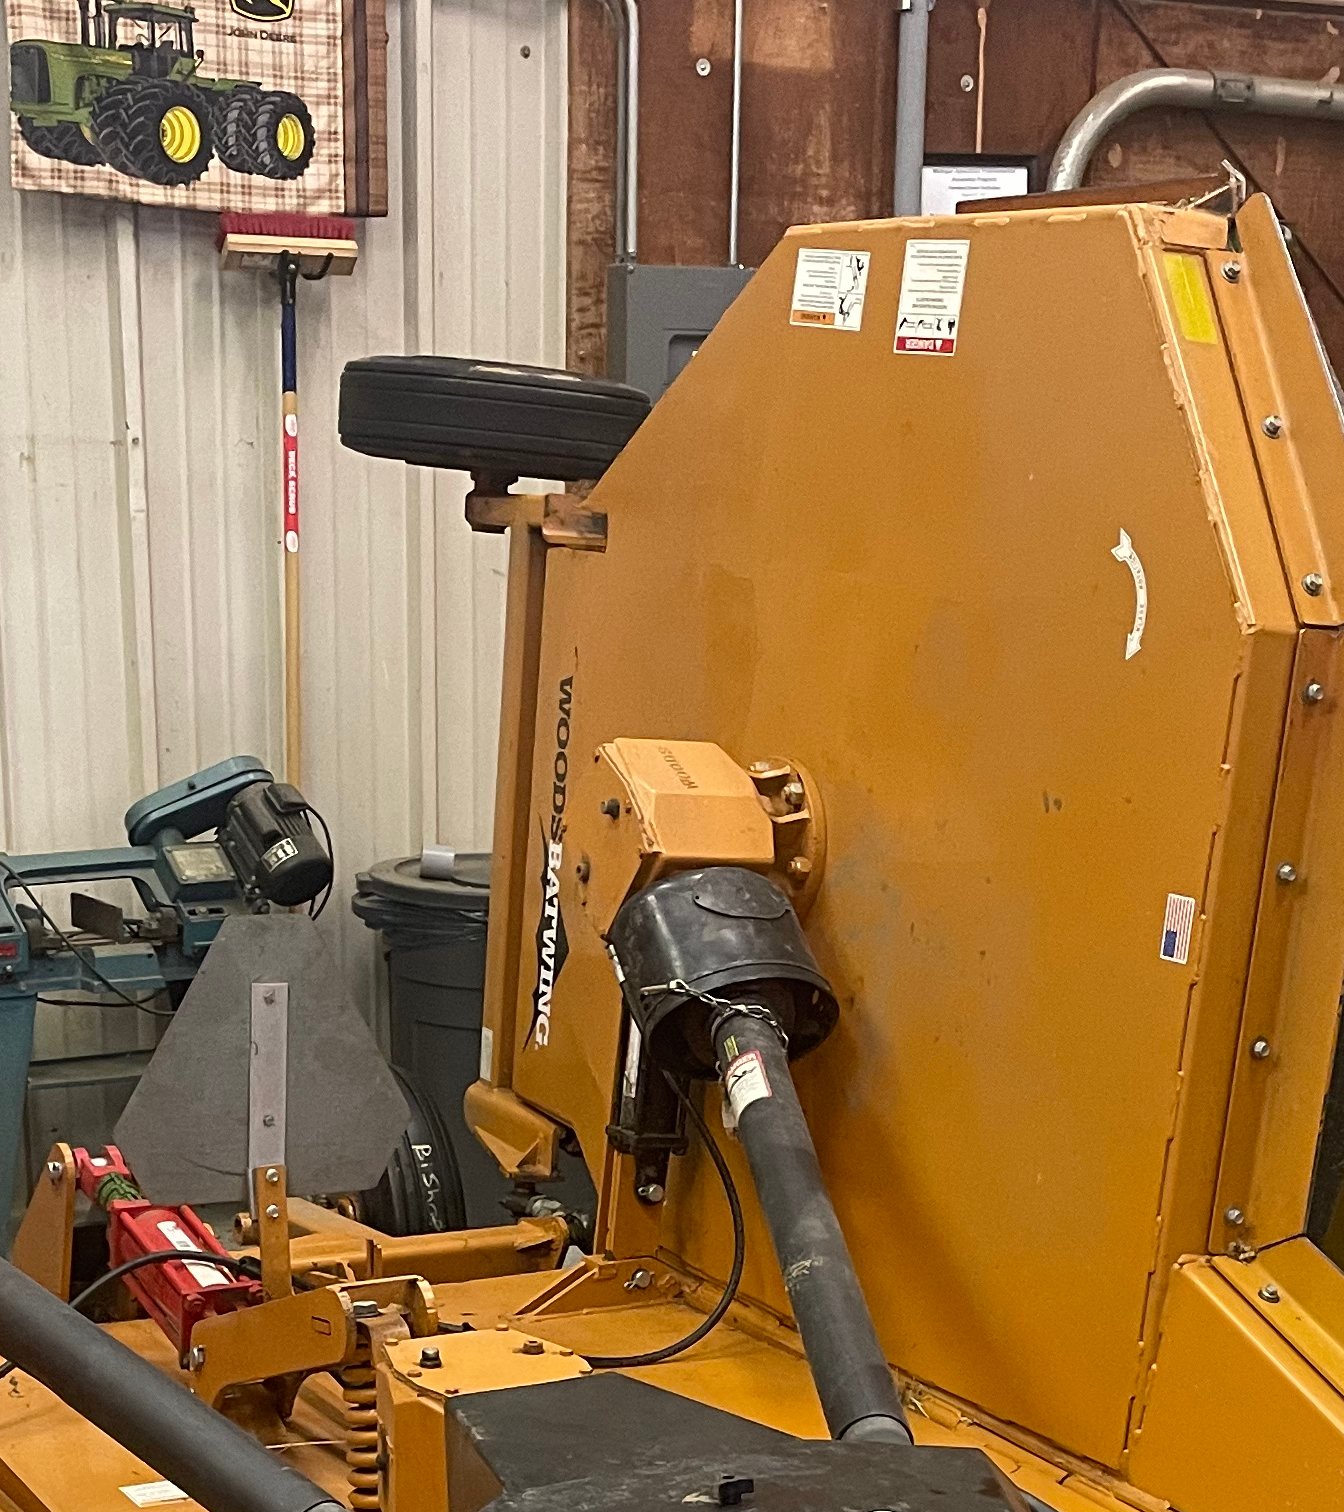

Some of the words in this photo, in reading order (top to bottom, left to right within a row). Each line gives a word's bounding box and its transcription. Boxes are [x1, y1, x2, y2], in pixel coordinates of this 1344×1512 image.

[227, 26, 258, 40] JOHN
[259, 31, 297, 43] DEERE
[550, 675, 574, 843] WOODS
[535, 839, 564, 1048] BATWING
